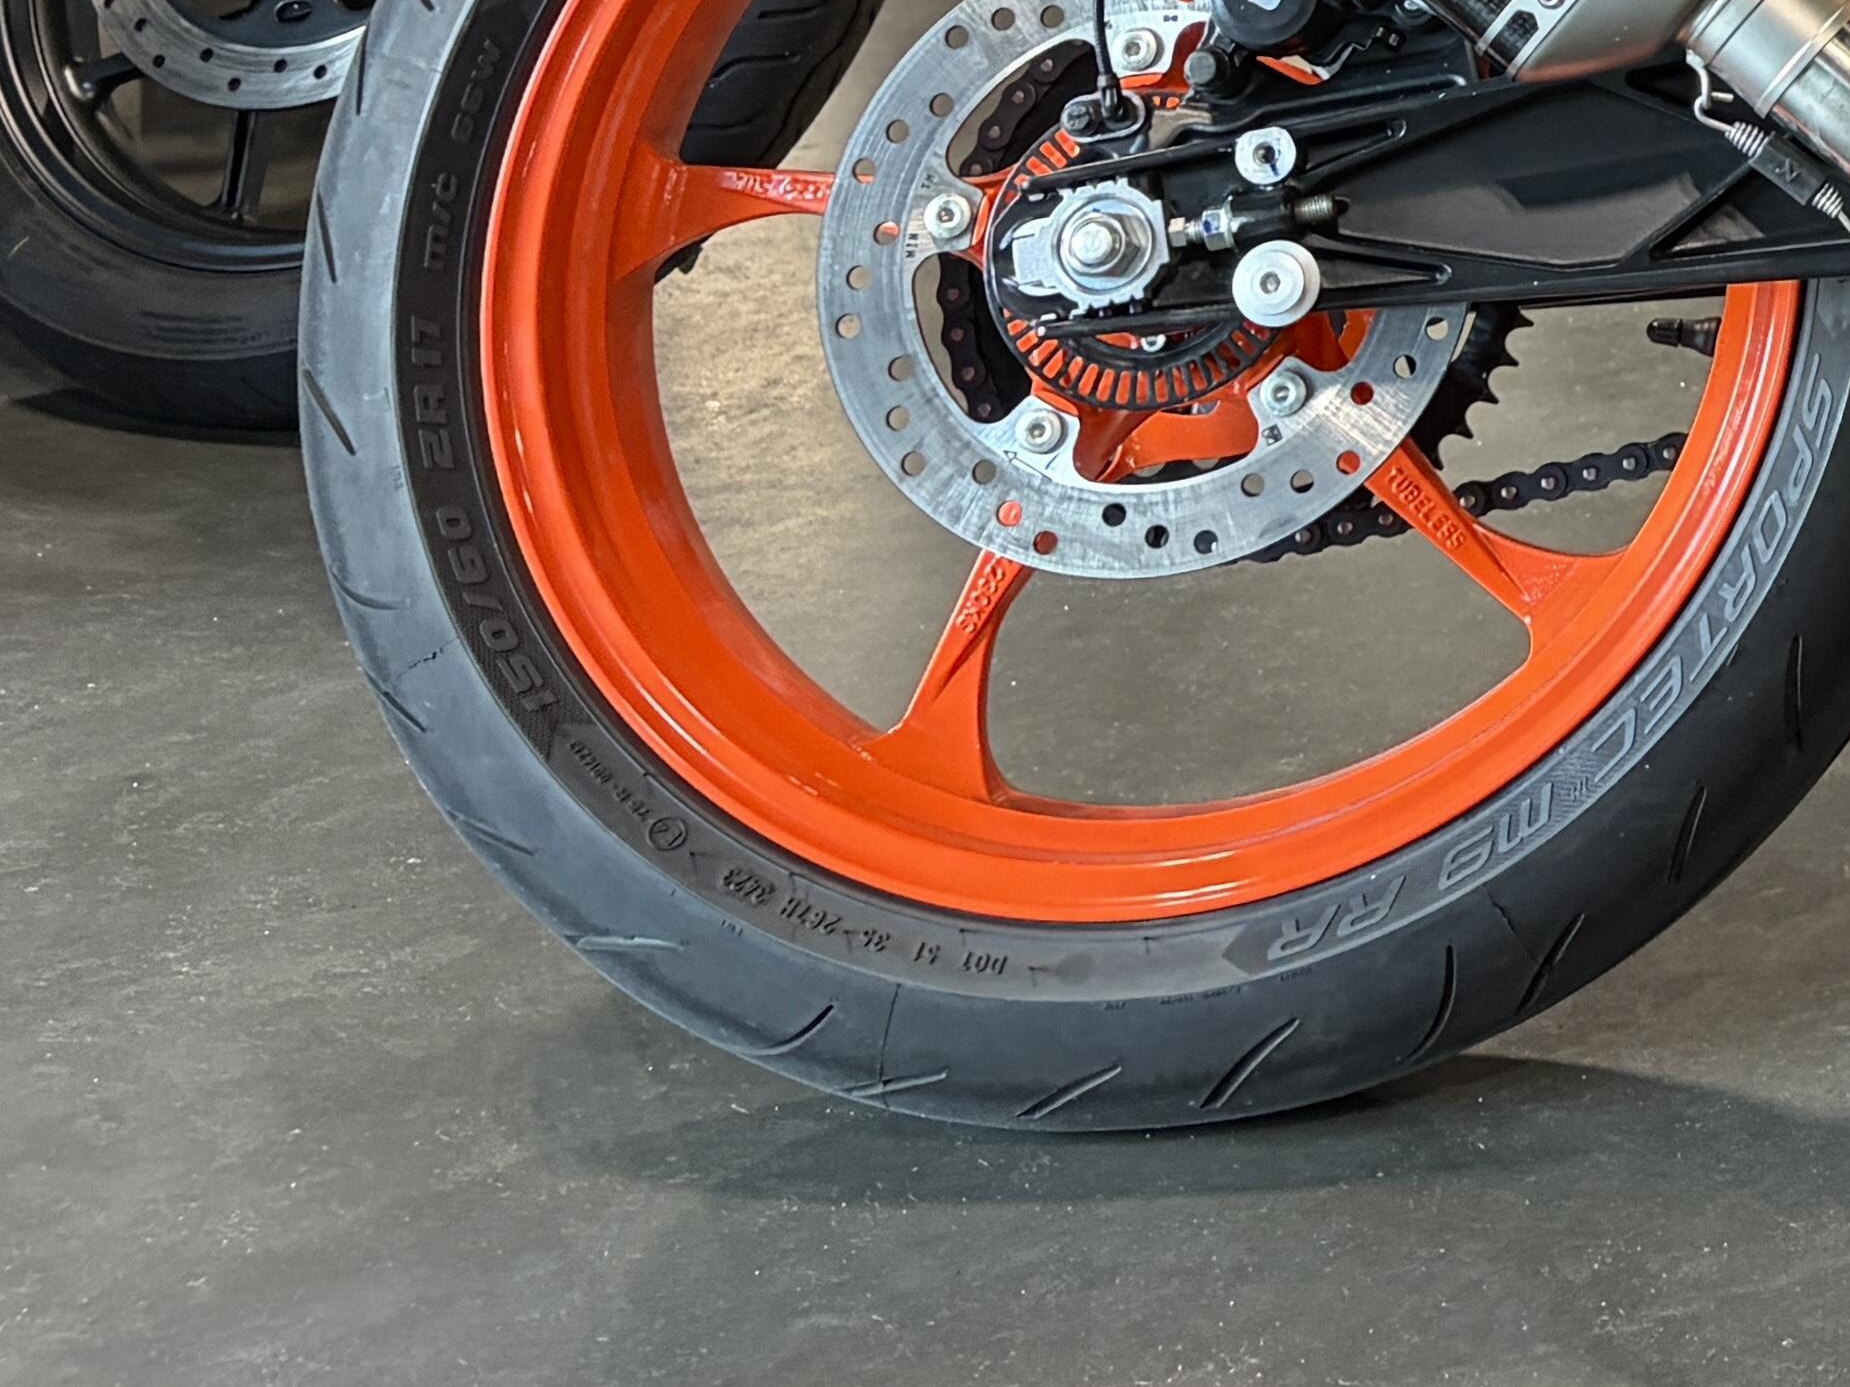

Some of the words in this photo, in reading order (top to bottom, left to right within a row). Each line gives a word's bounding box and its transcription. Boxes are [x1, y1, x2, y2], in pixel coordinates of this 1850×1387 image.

[1386, 465, 1466, 549] TUBELESS
[1590, 352, 1834, 785] SPORTEC
[435, 505, 560, 713] 150/60
[1267, 874, 1408, 961] RR
